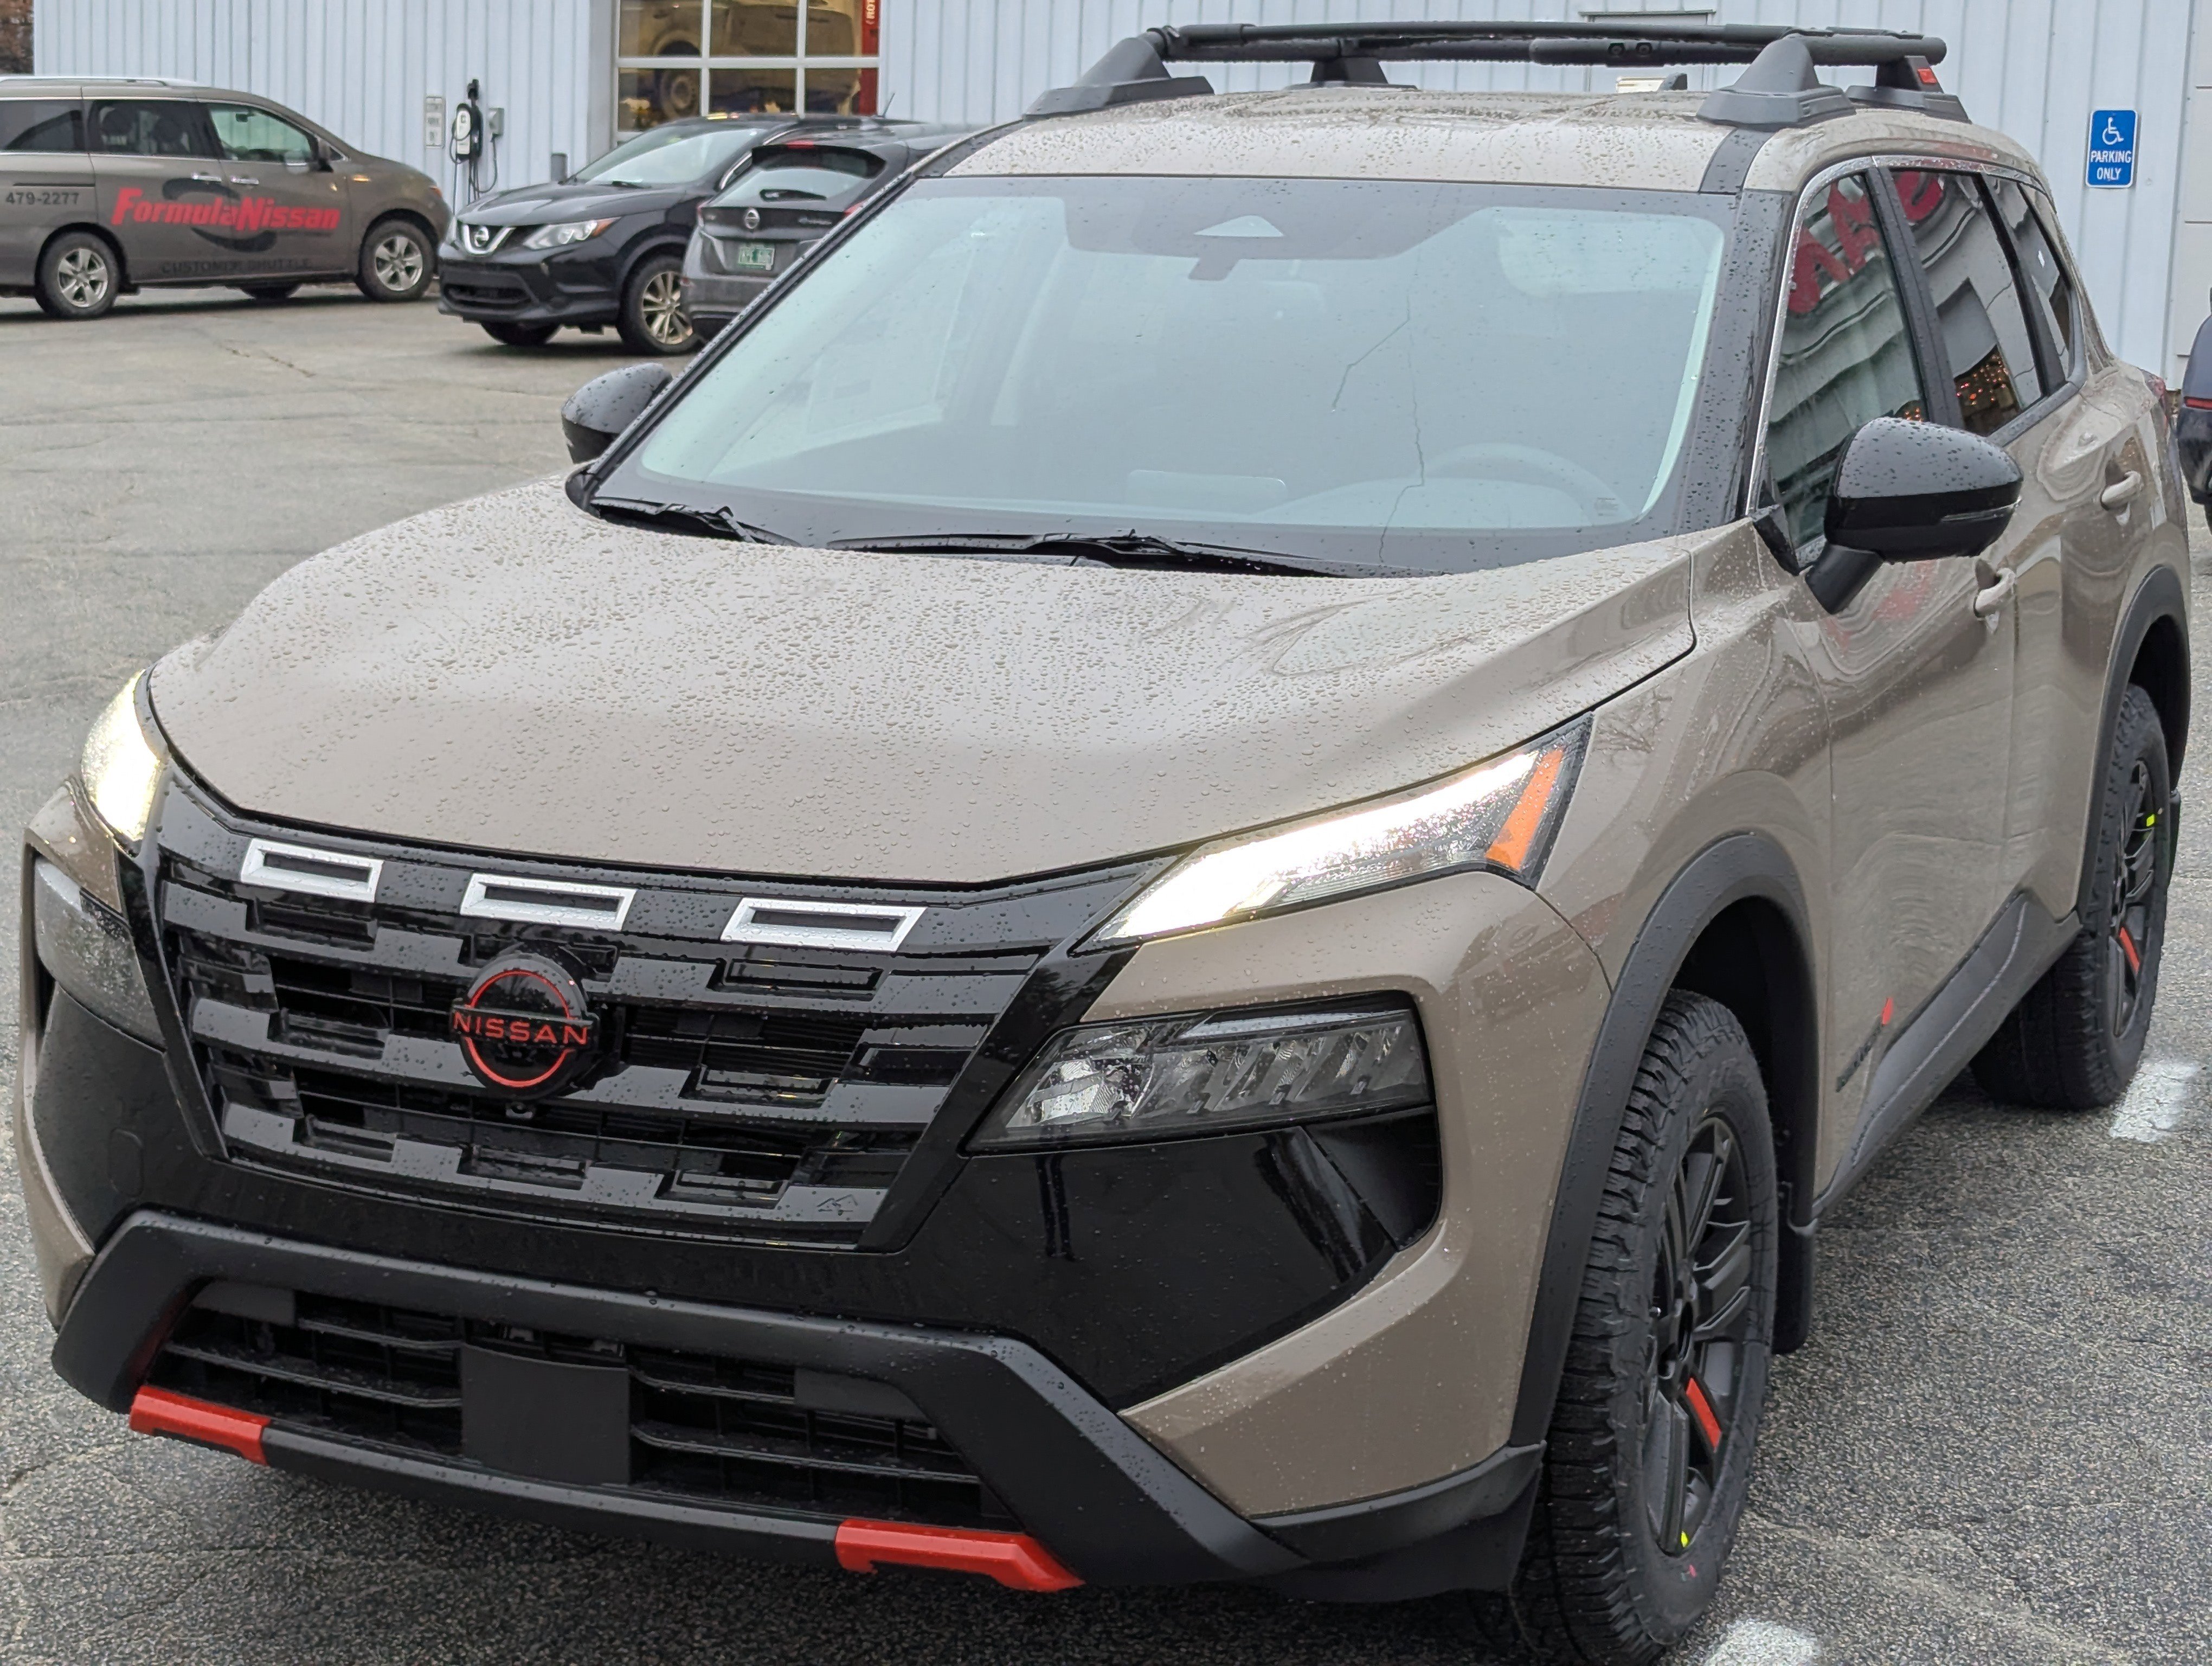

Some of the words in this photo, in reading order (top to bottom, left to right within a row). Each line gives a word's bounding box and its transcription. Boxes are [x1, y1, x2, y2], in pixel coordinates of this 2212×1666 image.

[2091, 150, 2132, 163] PARKING
[2097, 168, 2121, 180] ONLY
[5, 191, 80, 206] 479-2277
[453, 1010, 589, 1046] NISSAN
